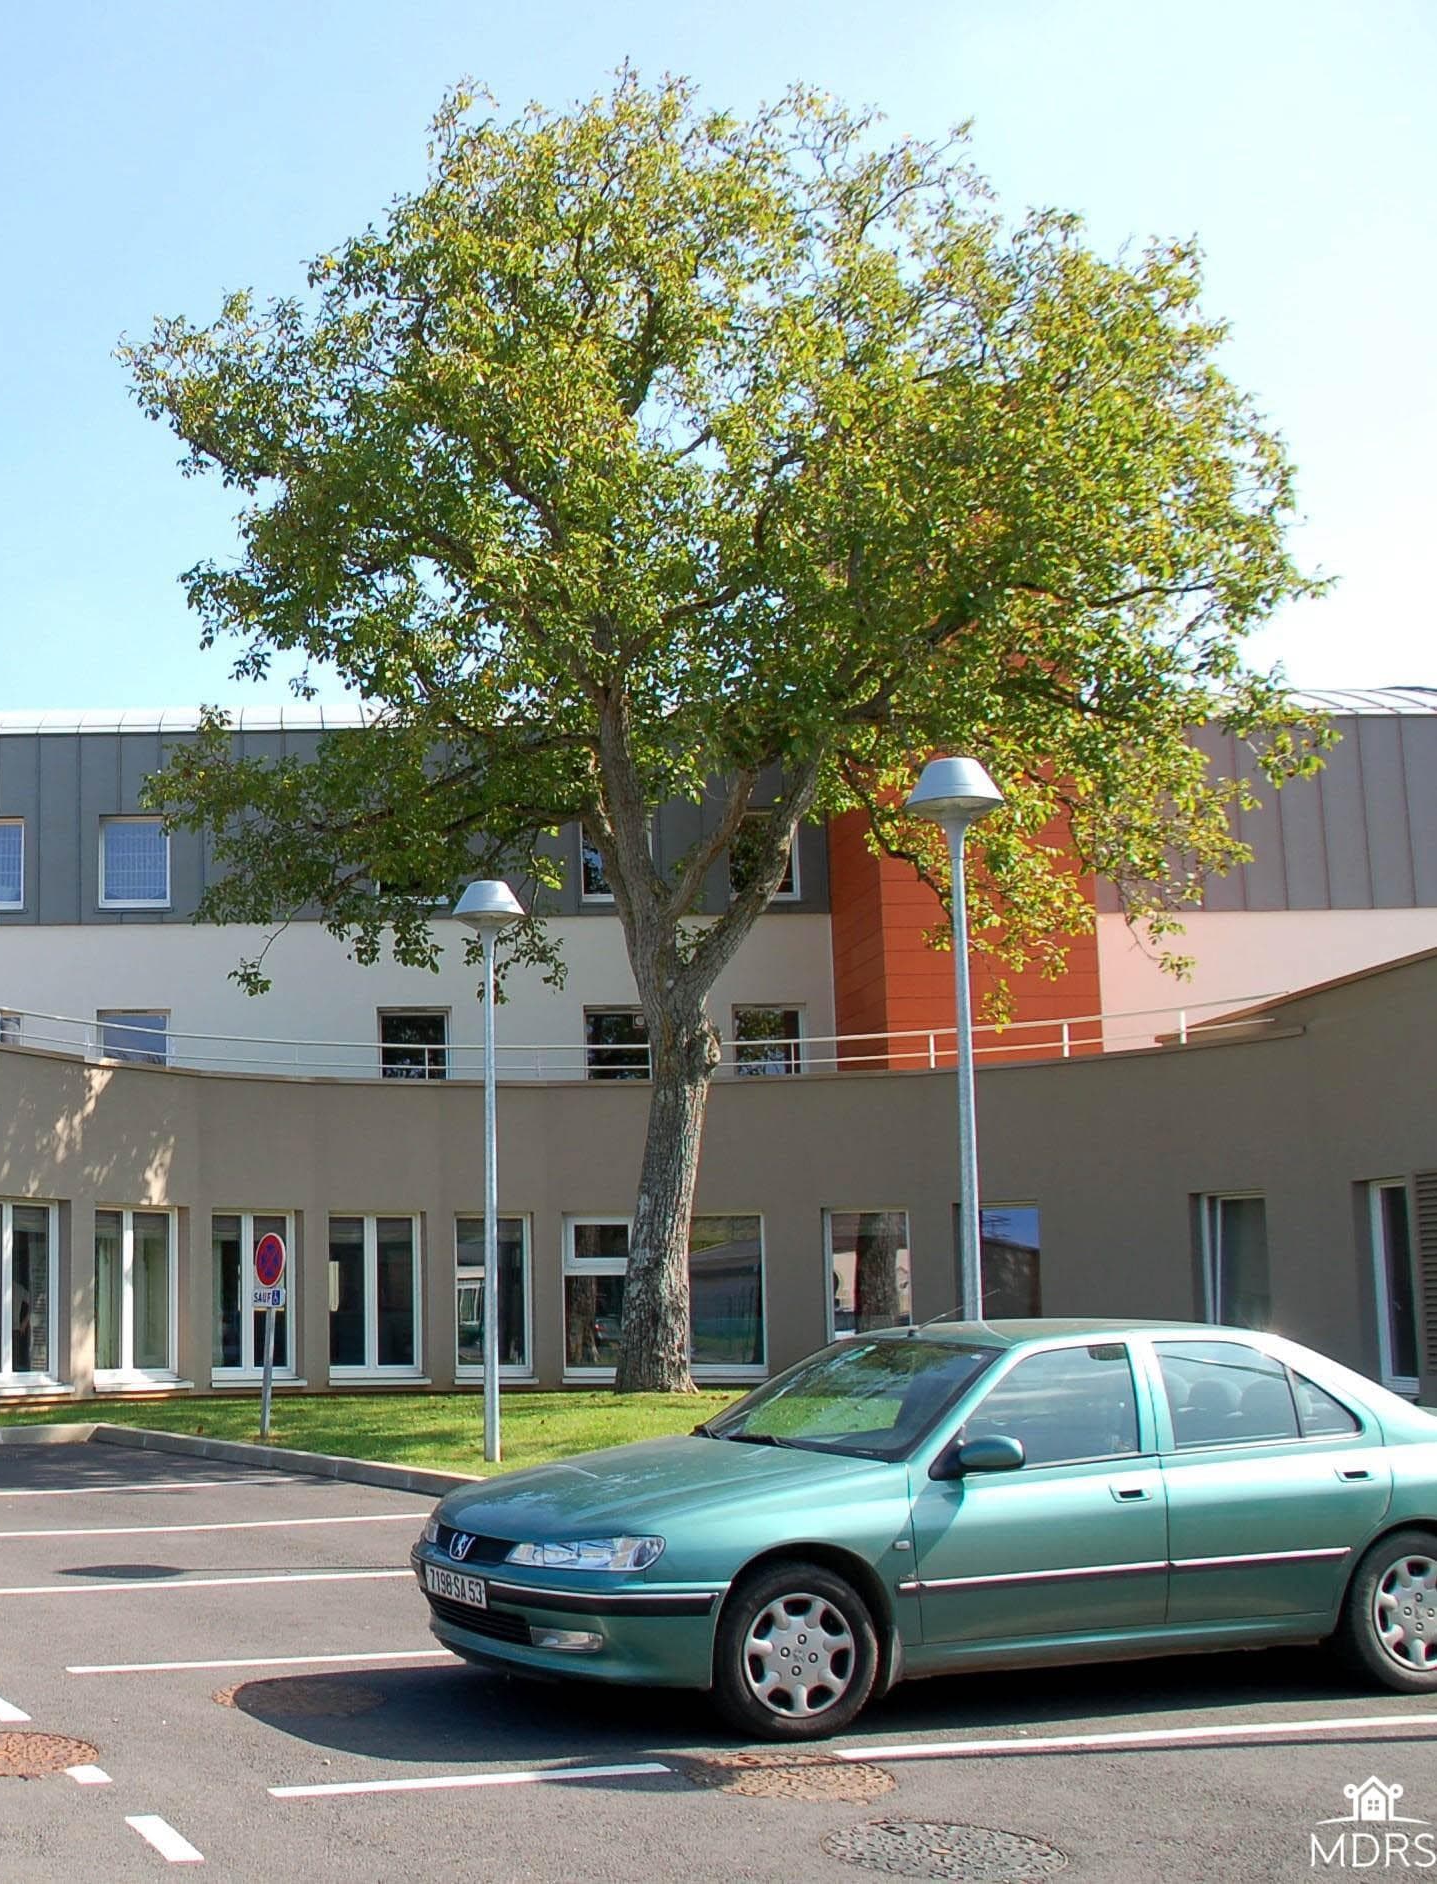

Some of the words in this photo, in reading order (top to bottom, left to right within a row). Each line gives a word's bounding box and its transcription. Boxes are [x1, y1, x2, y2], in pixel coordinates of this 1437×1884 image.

[253, 1291, 271, 1303] SAUF
[430, 1569, 453, 1595] 7198
[454, 1576, 466, 1601] SA
[468, 1580, 482, 1604] 53
